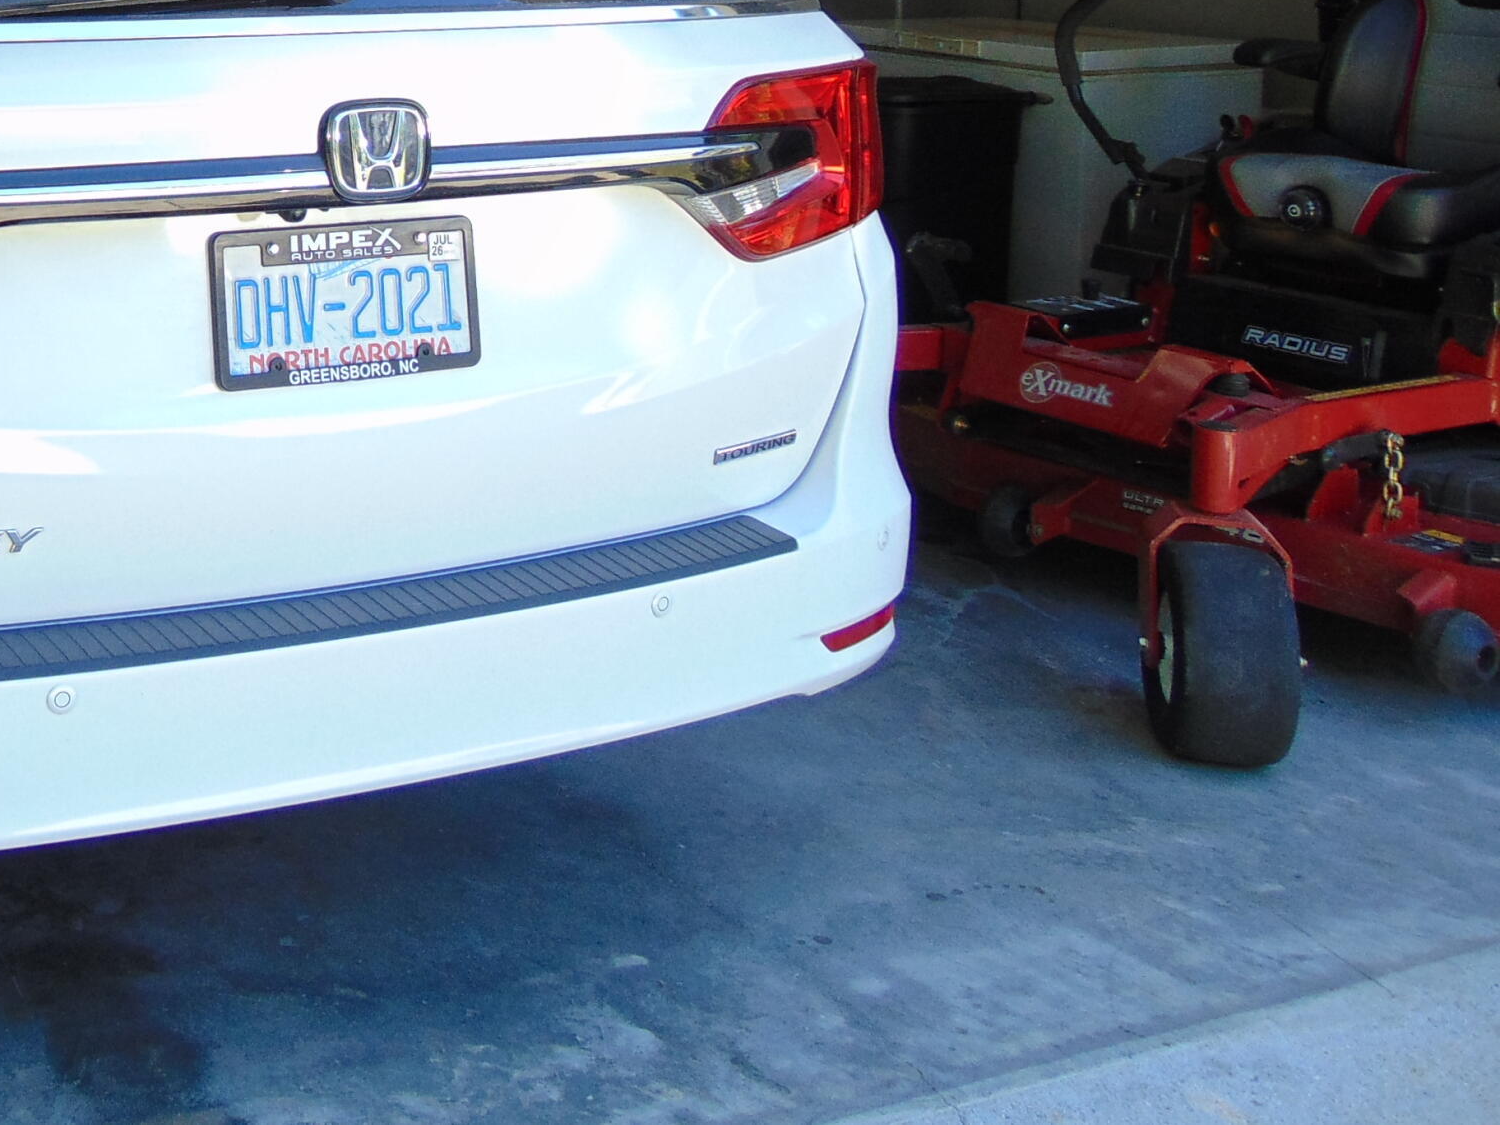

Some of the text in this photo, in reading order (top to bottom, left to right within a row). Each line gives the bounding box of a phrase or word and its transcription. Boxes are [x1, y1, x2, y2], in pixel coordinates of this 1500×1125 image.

[290, 226, 402, 252] IMPEX
[432, 245, 443, 256] 26
[433, 234, 453, 245] JUL
[291, 246, 394, 261] AUTO SALES
[235, 262, 462, 350] DHV-2021
[1244, 327, 1350, 362] RADIUS
[288, 359, 419, 386] GREENSBORO, NC
[1021, 367, 1114, 408] eXmark
[722, 433, 795, 461] TOURING
